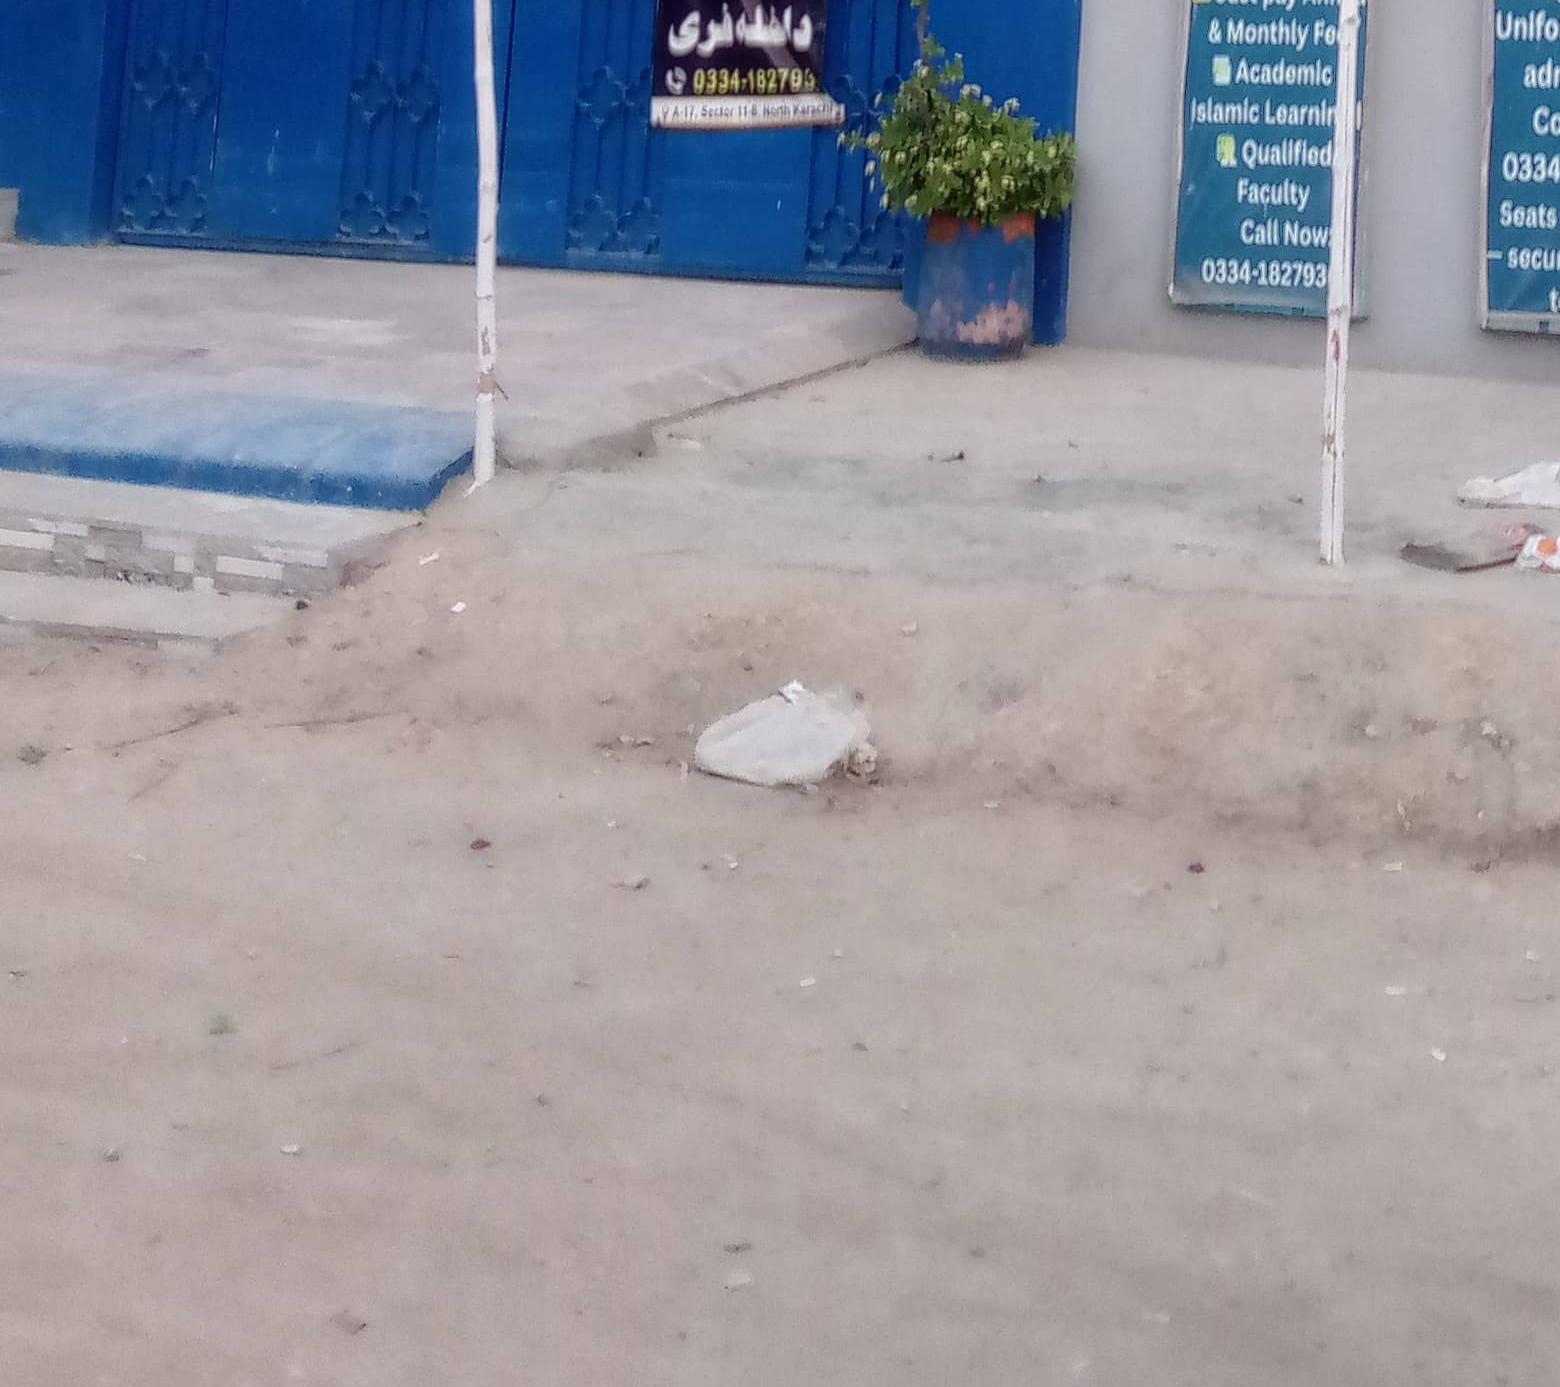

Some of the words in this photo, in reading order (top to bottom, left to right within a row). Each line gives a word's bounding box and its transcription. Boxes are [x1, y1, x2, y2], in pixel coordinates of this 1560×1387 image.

[1208, 19, 1222, 45] &
[1226, 19, 1310, 51] Monthly
[1234, 59, 1333, 86] Academic
[1190, 99, 1260, 125] Islamic
[1241, 140, 1333, 168] Qualified
[1237, 179, 1311, 212] Faculty
[1500, 200, 1557, 229] Seats
[1240, 219, 1280, 247] Call
[1201, 259, 1328, 288] 0334-182793
